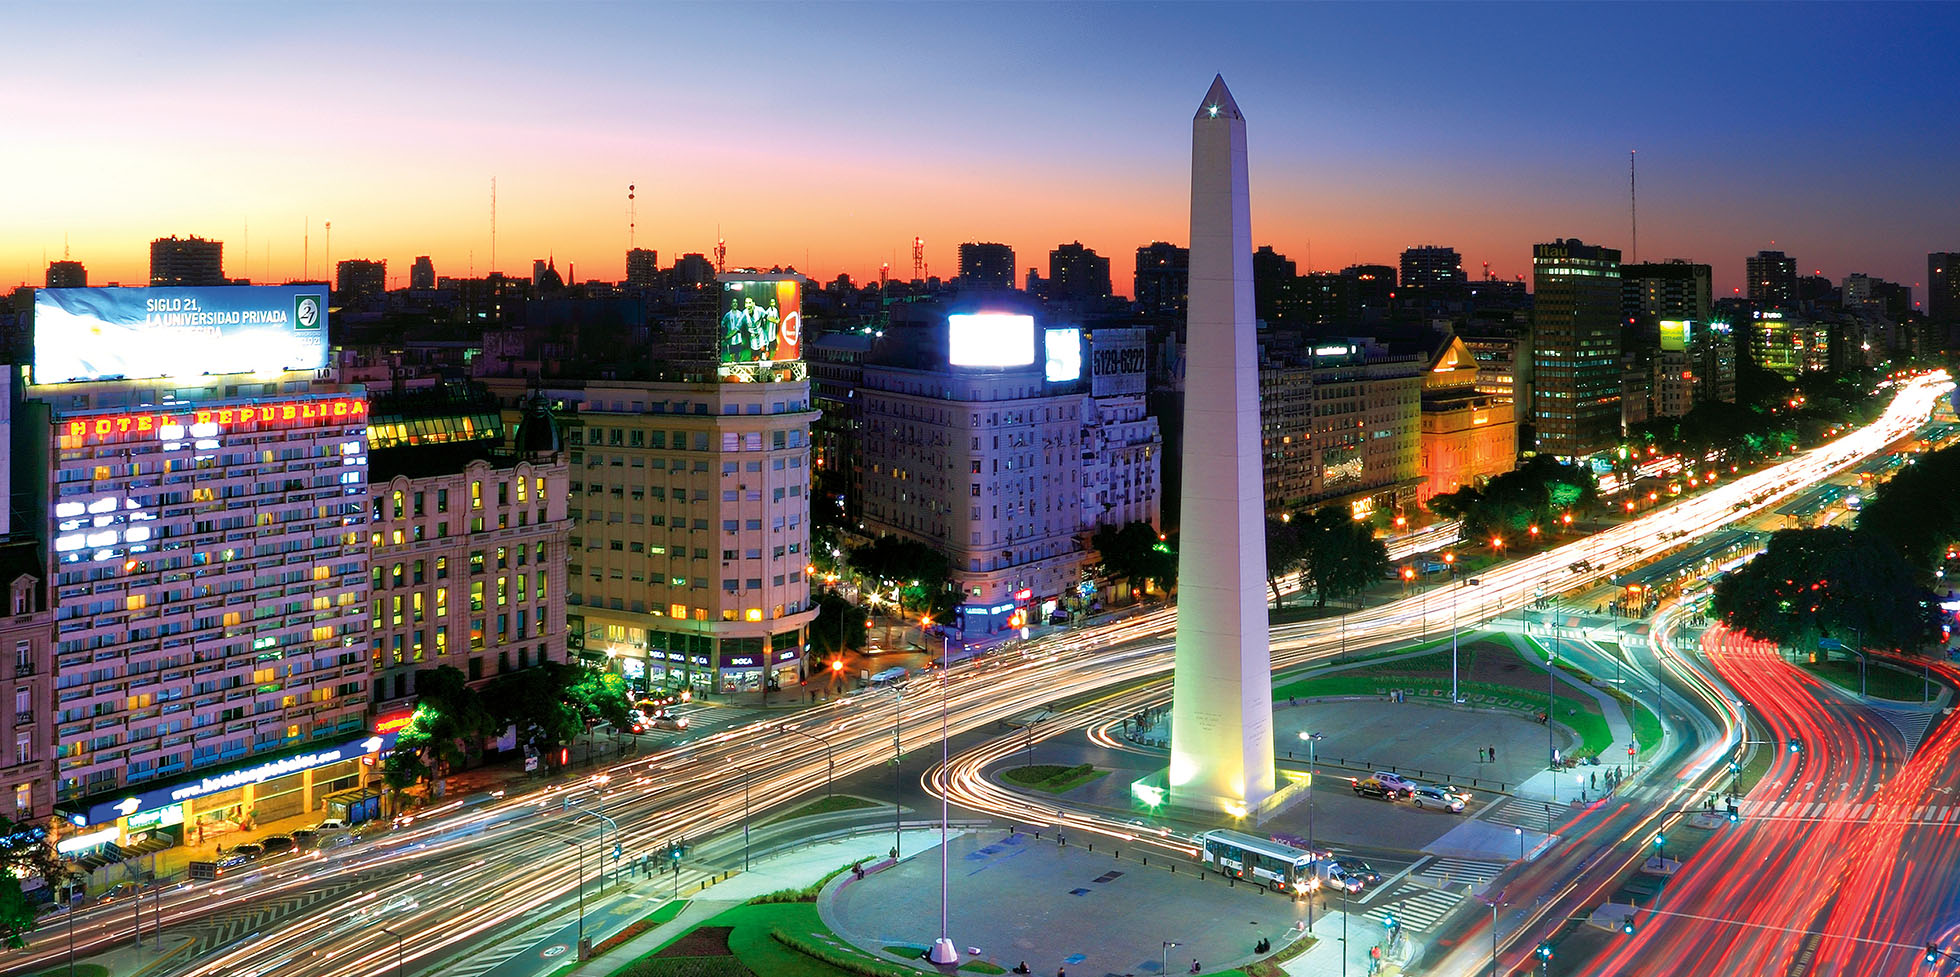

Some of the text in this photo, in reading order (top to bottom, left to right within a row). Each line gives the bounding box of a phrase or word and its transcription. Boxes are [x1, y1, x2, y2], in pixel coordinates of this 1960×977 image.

[146, 298, 202, 312] SIGLO 21,
[146, 310, 288, 327] LA UNIVERSIDAD PRIVADA
[1094, 349, 1144, 375] 5129-6322
[71, 401, 364, 436] HOTEL REPUBLICA
